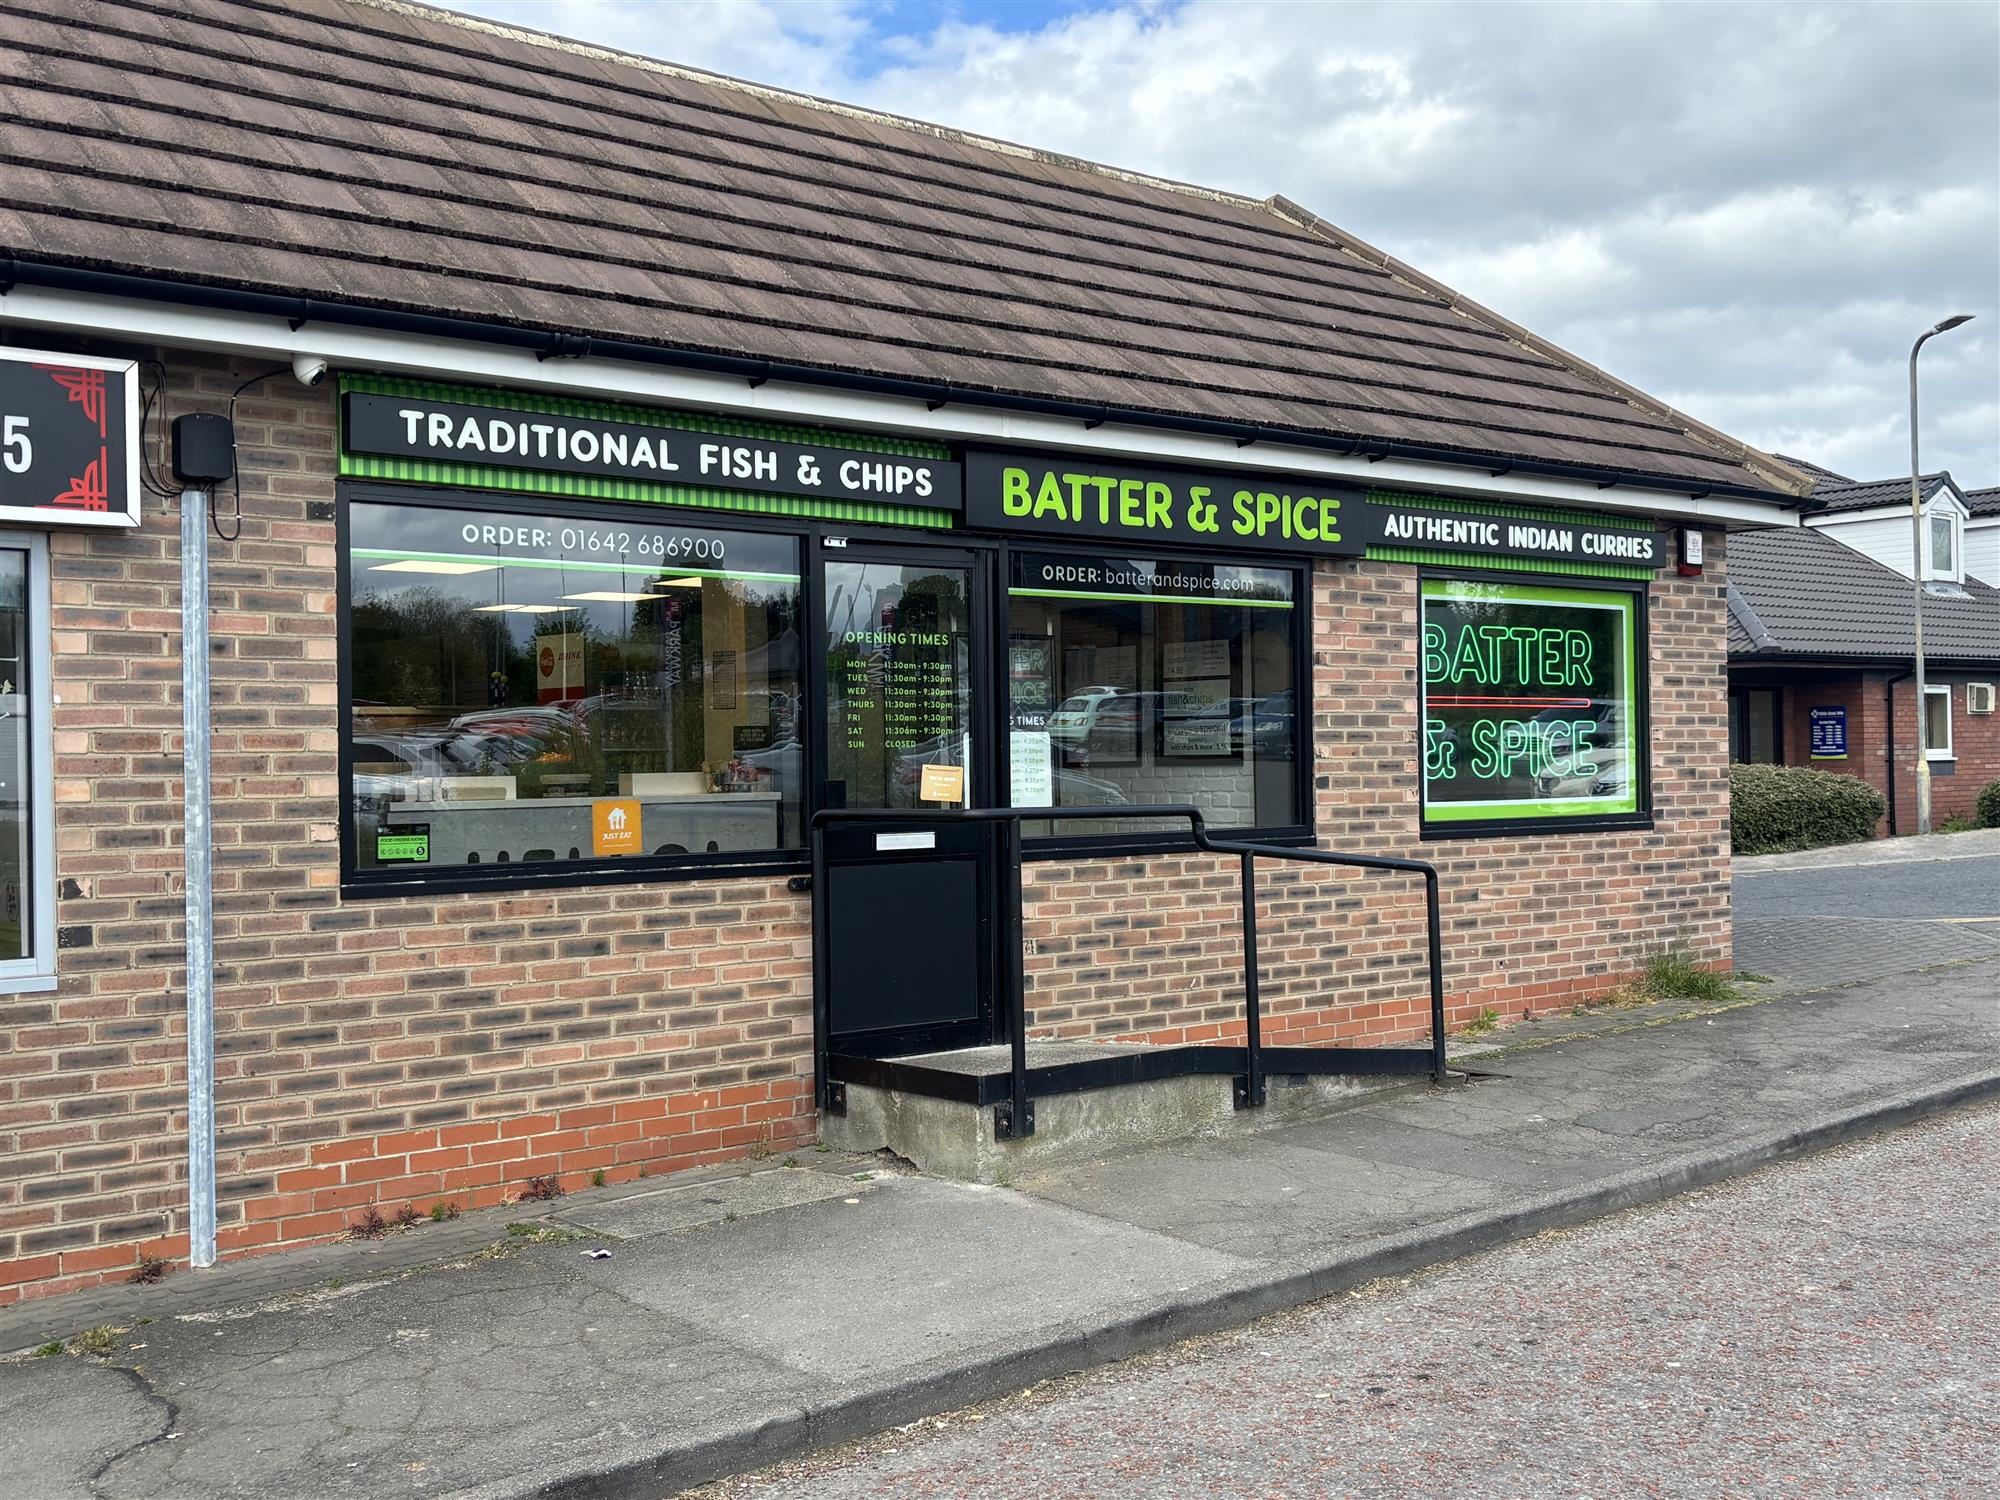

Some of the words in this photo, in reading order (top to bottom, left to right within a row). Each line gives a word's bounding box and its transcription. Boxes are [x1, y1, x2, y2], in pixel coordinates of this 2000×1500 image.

[3, 414, 33, 474] 5
[398, 409, 680, 472] TRADITIONAL
[699, 443, 778, 482] FISH
[796, 454, 822, 487] &
[838, 459, 934, 498] CHIPS
[1002, 467, 1174, 530] BATTER
[1186, 486, 1220, 534] &
[1231, 489, 1342, 542] SPICE
[461, 523, 552, 548] ORDER:
[561, 528, 631, 554] 01642
[637, 533, 726, 560] 686900
[1384, 513, 1500, 546] AUTHENTIC
[1508, 525, 1573, 553] INDIAN
[1581, 532, 1653, 559] CURRIES
[1041, 564, 1102, 584] ORDER:
[1105, 568, 1255, 593] batterandspice.com
[845, 630, 907, 645] OPENING
[909, 633, 950, 646] TIMES
[1425, 623, 1594, 687] BATTER
[846, 660, 867, 668] MON
[884, 661, 917, 669] 11:30am
[922, 662, 953, 671] 9:30pm
[847, 674, 869, 682] TUES
[884, 674, 917, 682] 11:30am
[922, 675, 953, 684] 9:30pm
[847, 687, 867, 695] WED
[884, 687, 917, 695] 11:30am
[922, 688, 953, 697] 9:30pm
[847, 700, 875, 708] THURS
[884, 701, 917, 709] 11:30am
[922, 701, 953, 711] 9:30pm
[847, 714, 861, 722] FRI
[884, 714, 917, 722] 11:30am
[922, 714, 953, 724] 9:30pm
[1016, 715, 1045, 726] TIMES
[847, 727, 863, 735] SAT
[884, 727, 917, 735] 11:30am
[922, 727, 953, 736] 9:30pm
[847, 740, 865, 748] SUN
[885, 740, 917, 748] CLOSED
[1425, 719, 1456, 780] &
[1471, 719, 1599, 779] SPICE
[619, 831, 633, 839] EAT
